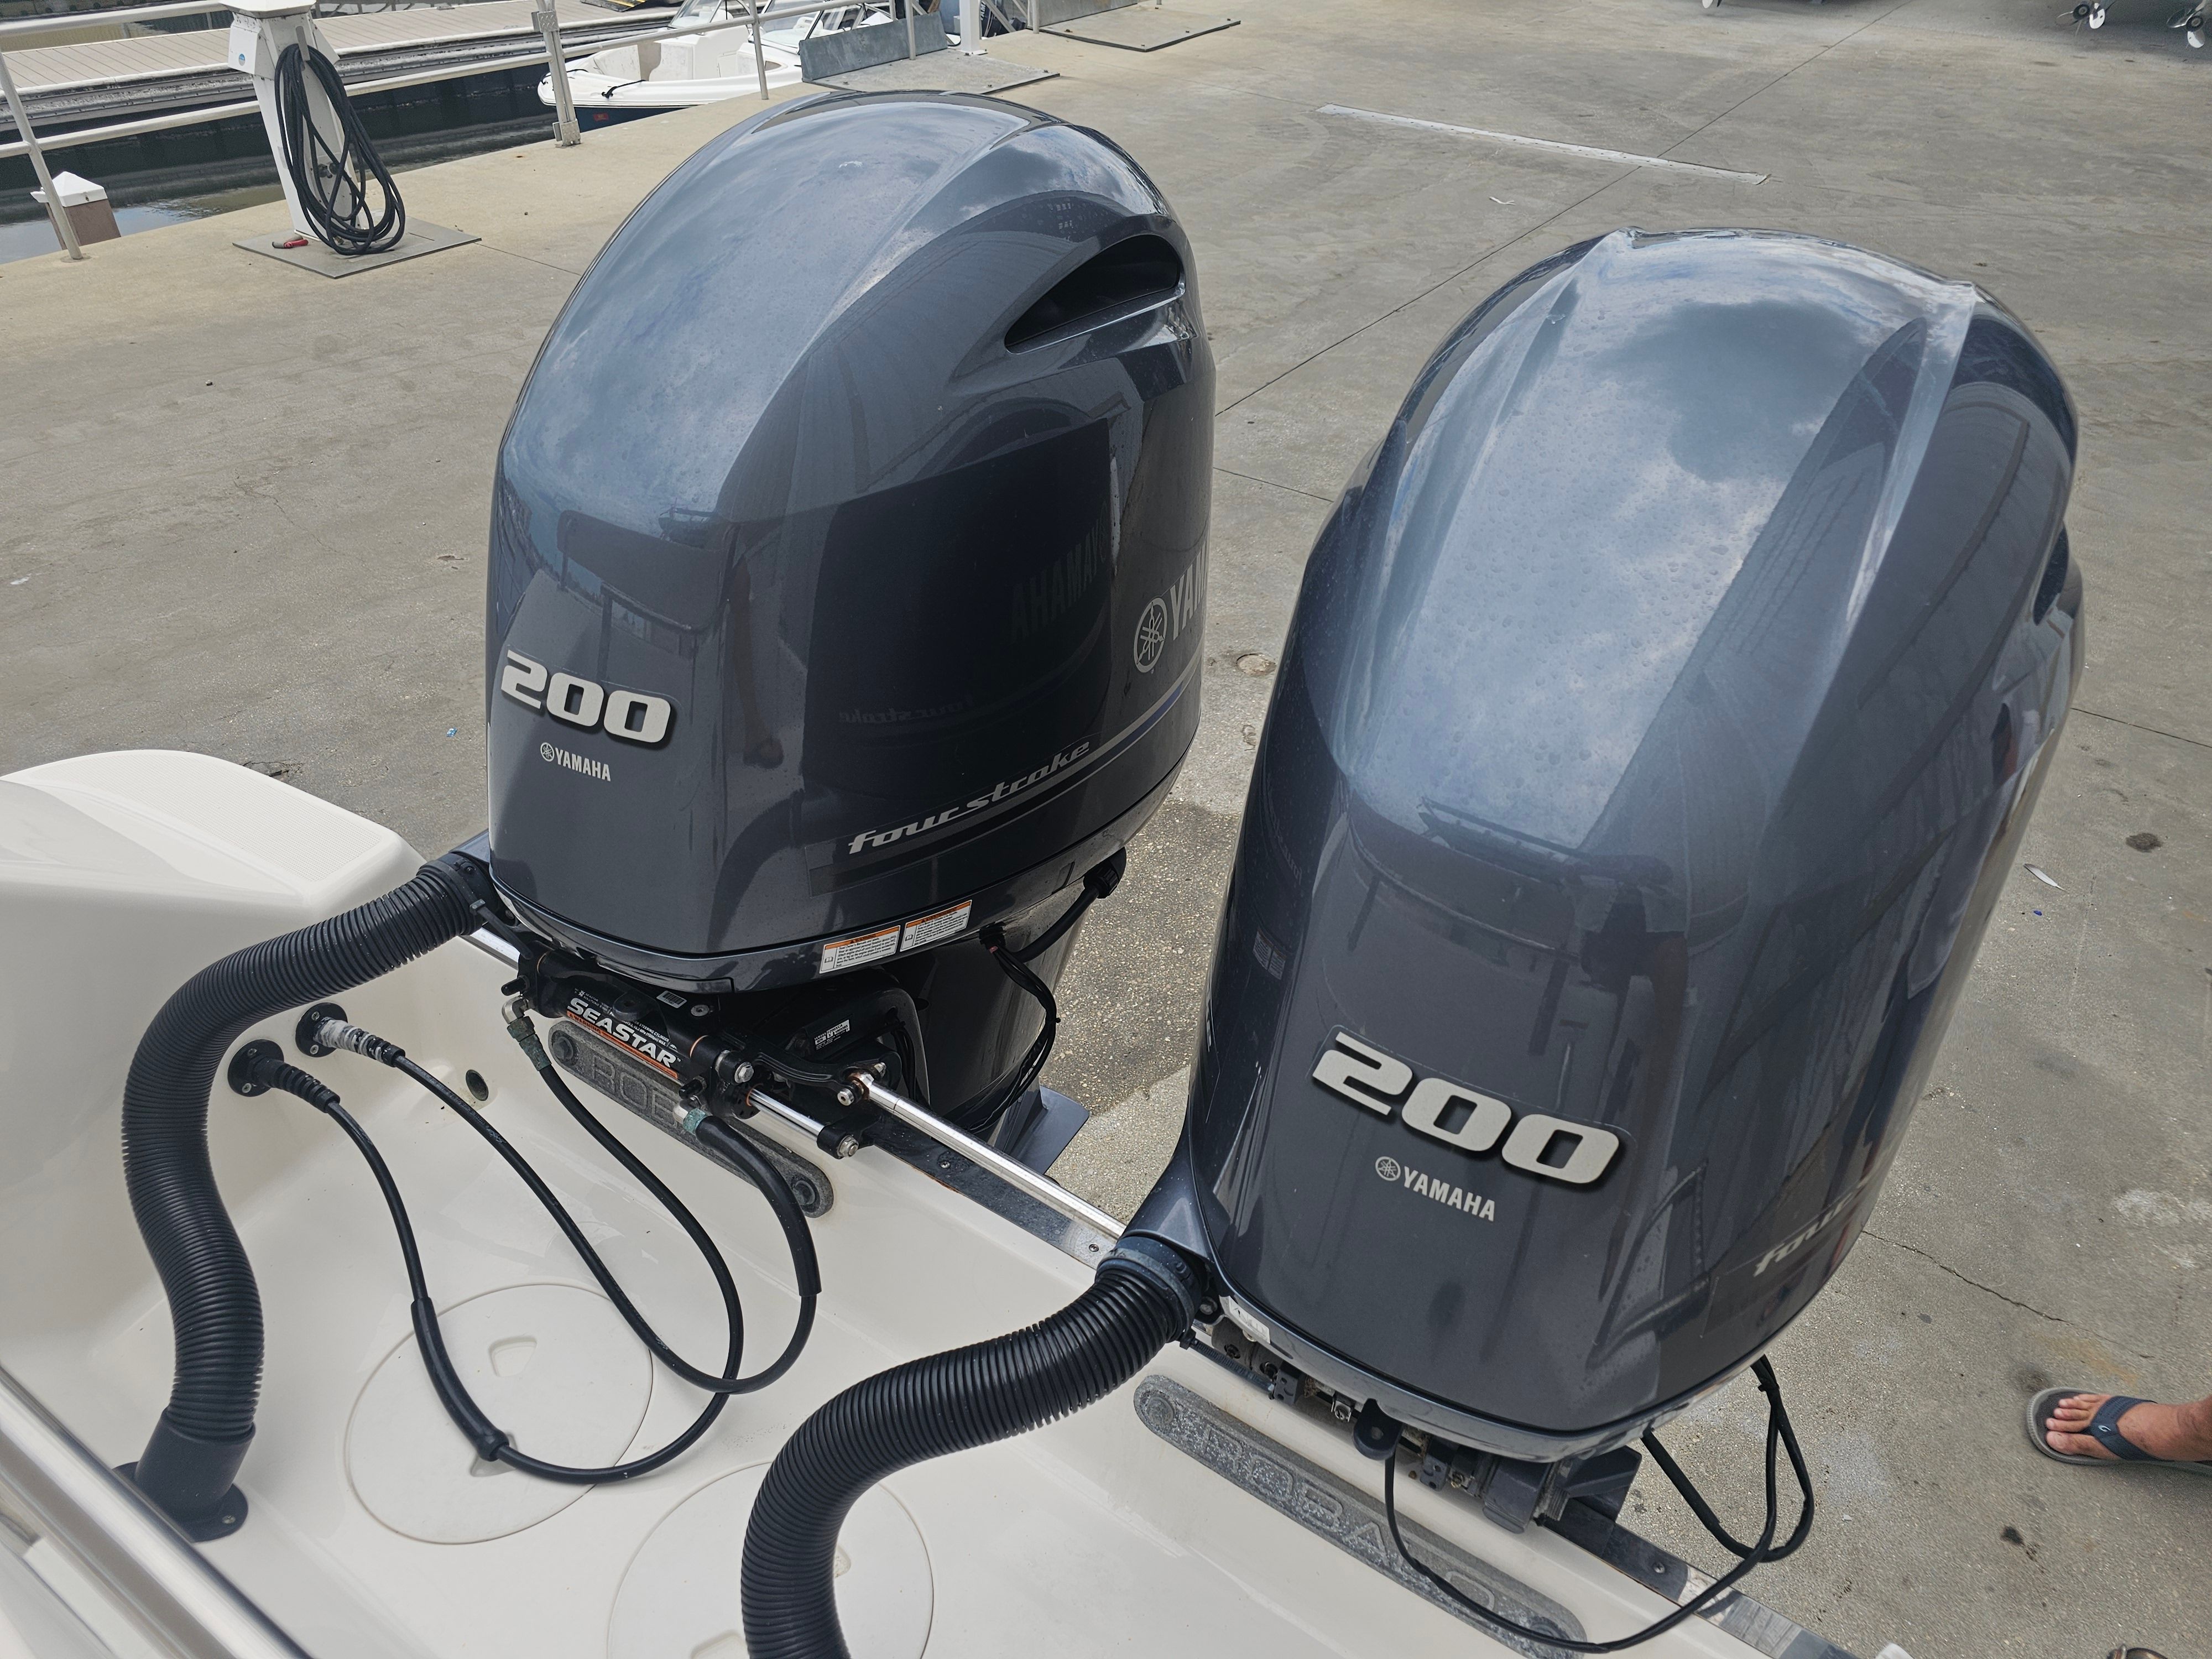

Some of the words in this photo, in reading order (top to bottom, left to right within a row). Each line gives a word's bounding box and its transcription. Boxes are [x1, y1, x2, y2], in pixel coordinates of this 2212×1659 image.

[501, 650, 671, 743] 200
[555, 747, 611, 782] YAMAHA
[567, 998, 676, 1068] SEASTAR
[1312, 1031, 1619, 1184] 200
[1404, 1166, 1496, 1221] YAMAHA
